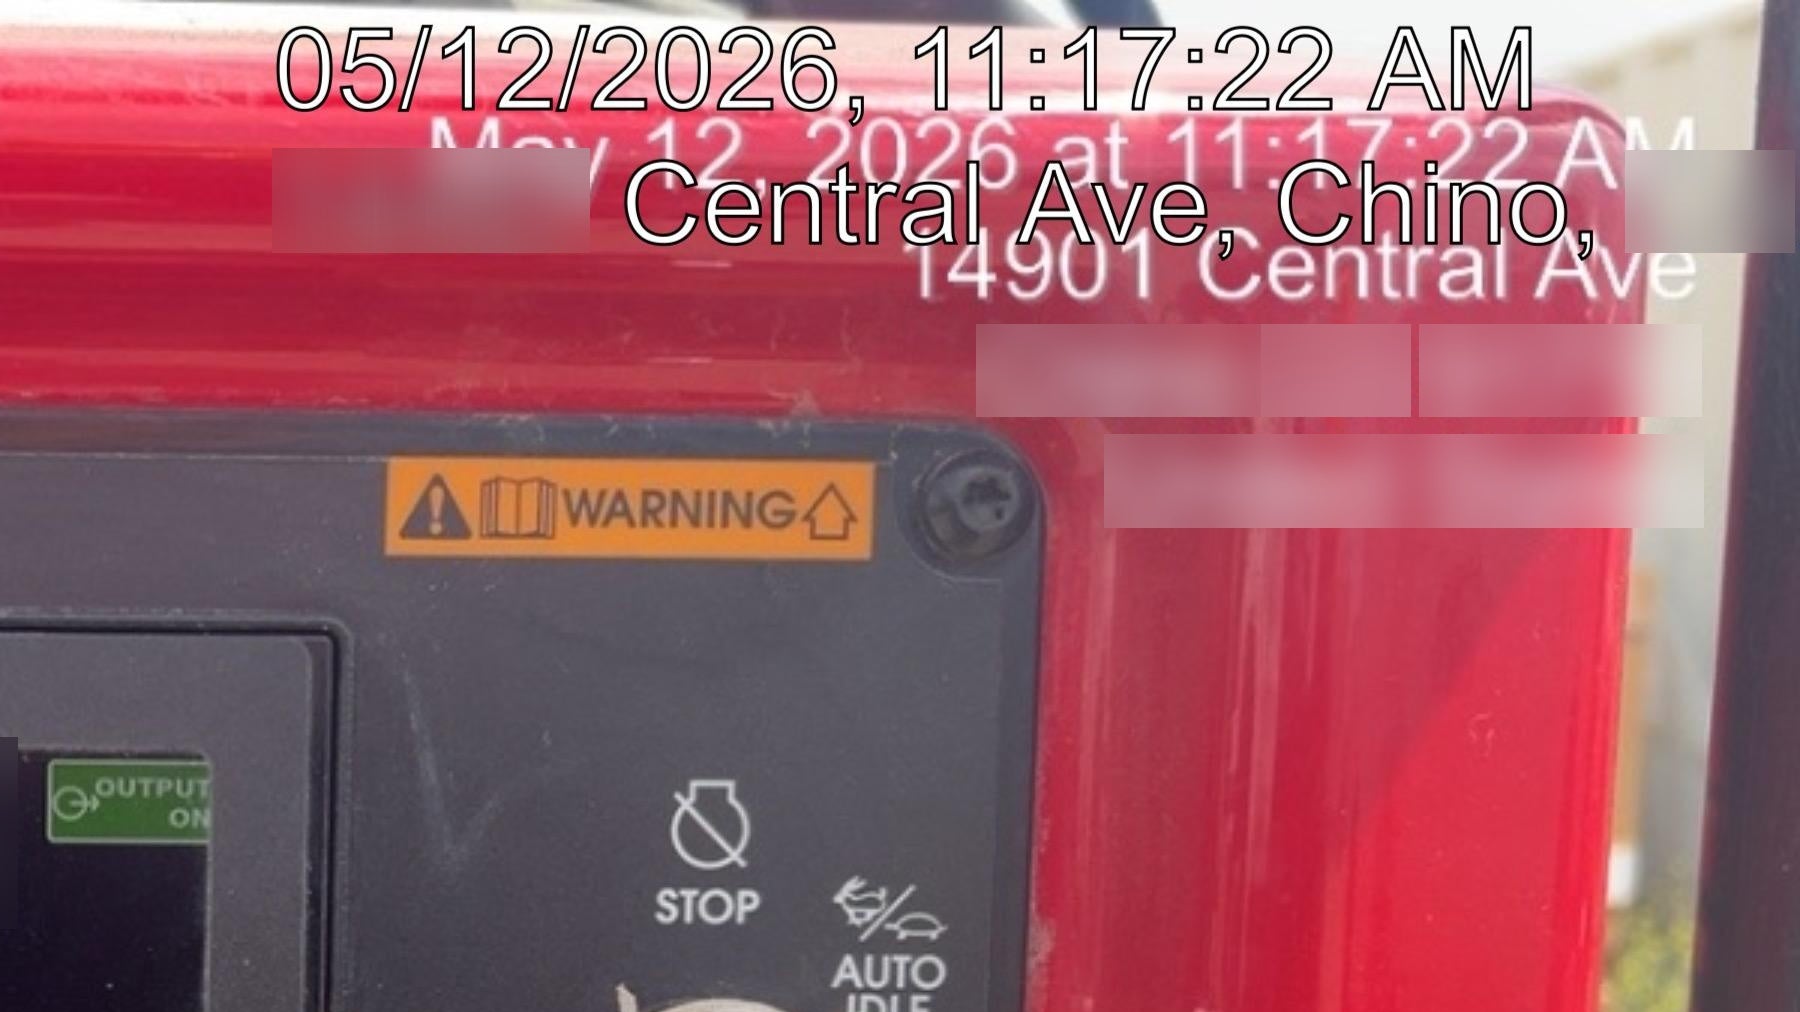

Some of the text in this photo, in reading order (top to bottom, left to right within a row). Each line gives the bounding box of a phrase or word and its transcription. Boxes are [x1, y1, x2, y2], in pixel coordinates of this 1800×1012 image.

[561, 488, 799, 530] WARNING
[94, 776, 211, 799] OUTPUT
[168, 806, 211, 830] ON
[653, 888, 762, 925] STOP
[830, 953, 948, 989] AUTO
